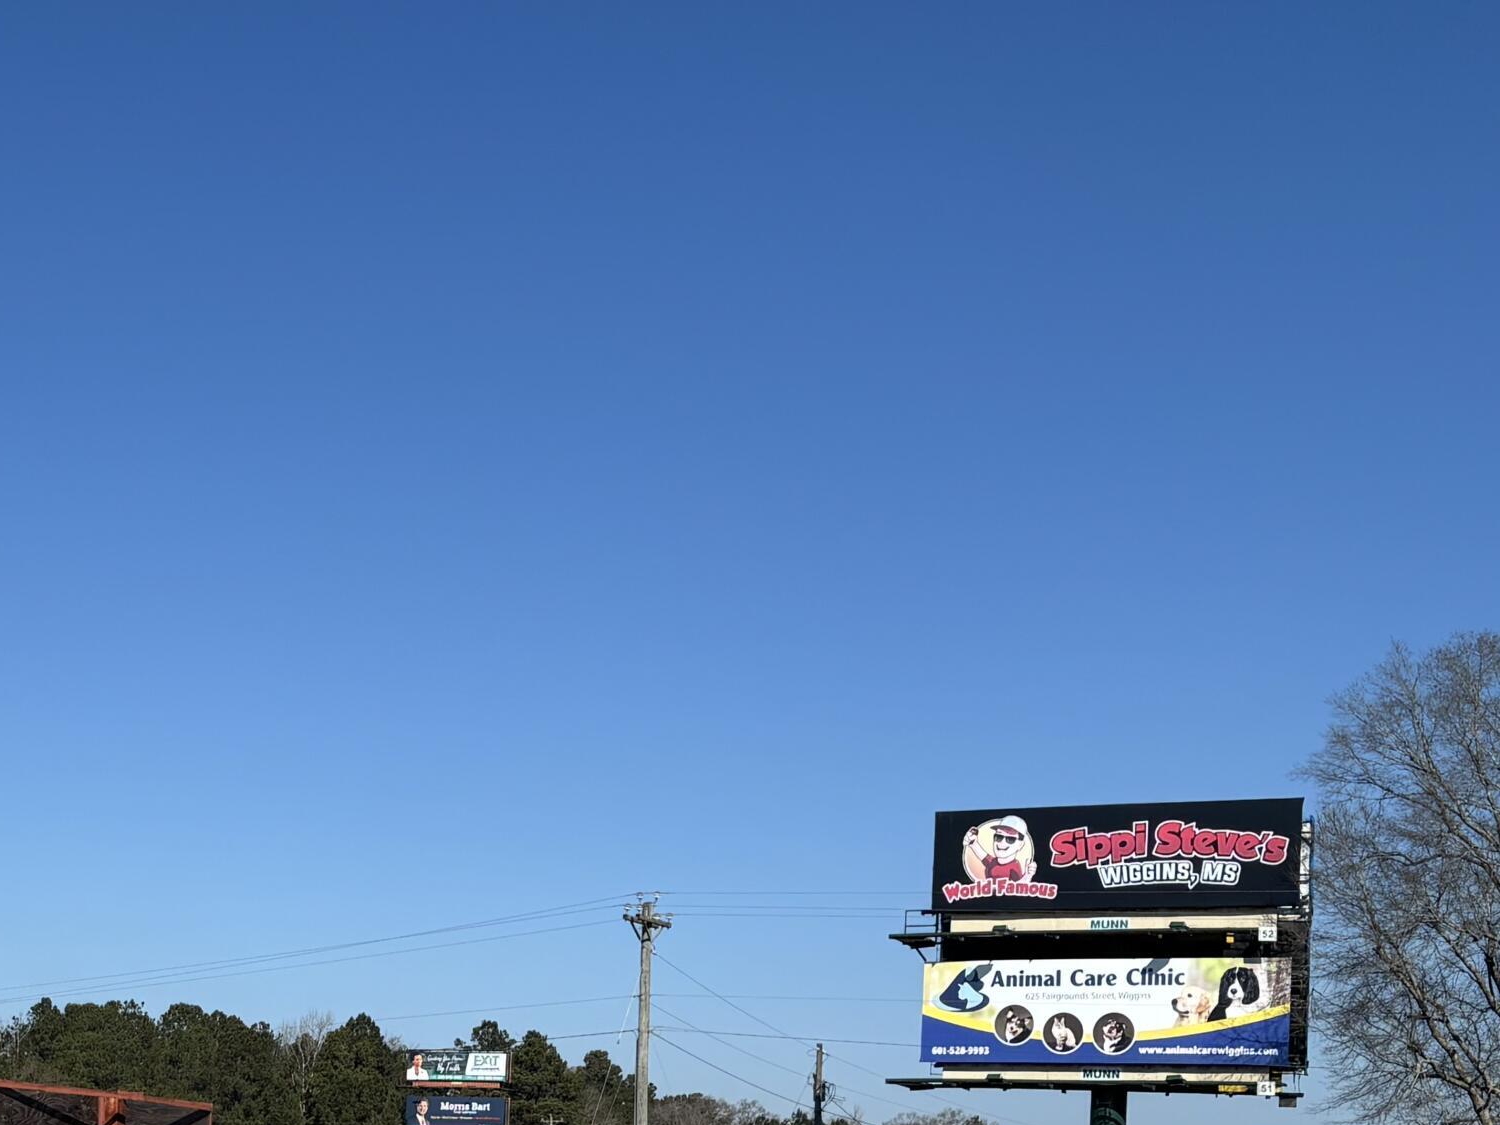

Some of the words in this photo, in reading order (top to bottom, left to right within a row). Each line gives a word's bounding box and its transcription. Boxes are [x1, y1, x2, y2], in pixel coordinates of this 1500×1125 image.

[1050, 821, 1148, 868] Sippi
[1153, 820, 1289, 865] Steve's
[1099, 861, 1198, 888] WIGGINS,
[1201, 861, 1240, 884] MS
[943, 881, 992, 902] World
[997, 879, 1057, 899] Famous
[1090, 919, 1129, 929] MUNN
[1262, 929, 1274, 938] 52
[991, 970, 1061, 987] Animal
[1070, 969, 1117, 987] Care
[1126, 968, 1185, 986] Clinic
[1025, 993, 1040, 1001] 625
[1042, 992, 1089, 1002] Fairgrounds
[1138, 1045, 1279, 1057] www.animalcarewiggins.com
[1082, 1069, 1121, 1079] MUNN
[1260, 1084, 1272, 1092] 51
